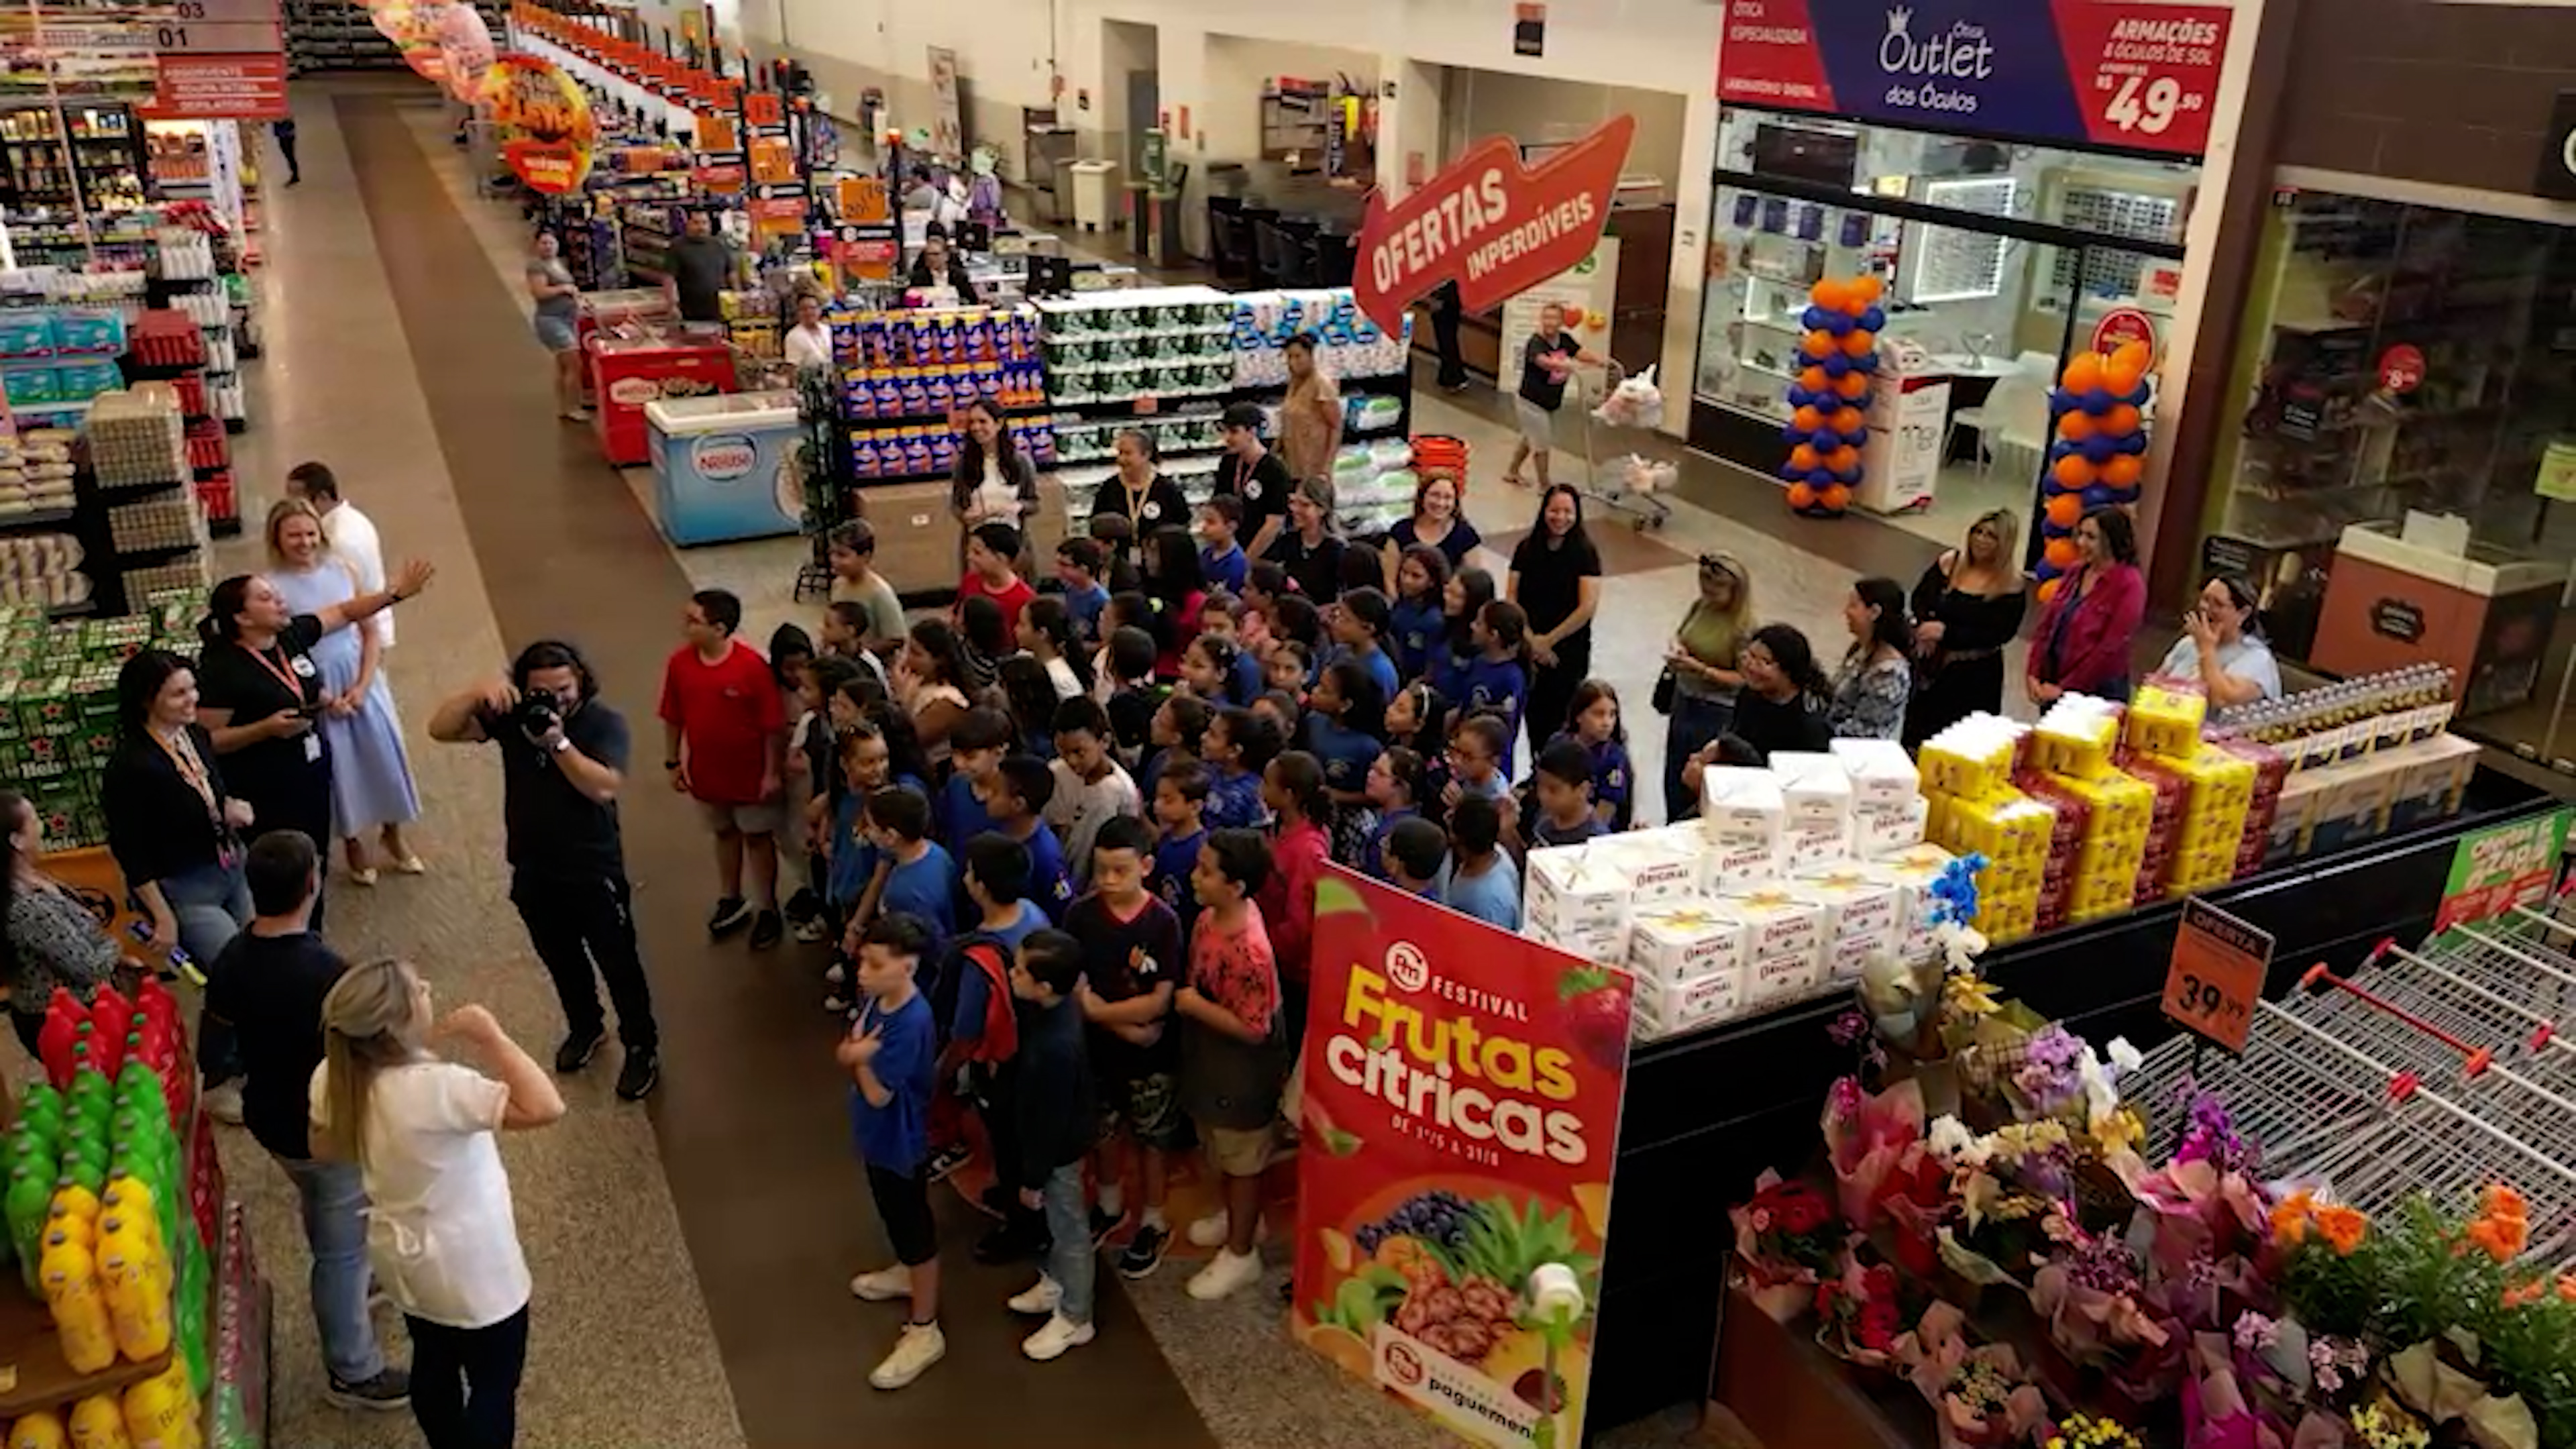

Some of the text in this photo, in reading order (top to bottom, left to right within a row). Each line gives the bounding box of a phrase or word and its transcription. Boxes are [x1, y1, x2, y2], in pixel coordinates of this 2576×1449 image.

[158, 28, 187, 47] 01
[1880, 31, 1994, 80] Outlet
[2110, 17, 2219, 46] ARMAÇÕES
[2165, 43, 2186, 63] DE
[2186, 46, 2213, 66] SOL
[1885, 80, 1978, 113] dos Óculos
[1373, 168, 1507, 294] OFERTAS
[1466, 191, 1595, 281] IMPERDÍVEIS
[2192, 909, 2258, 955] OFERTA
[1432, 975, 1529, 1023] FESTIVAL
[1344, 963, 1576, 1102] Frutas
[1429, 1377, 1536, 1440] paguemen
